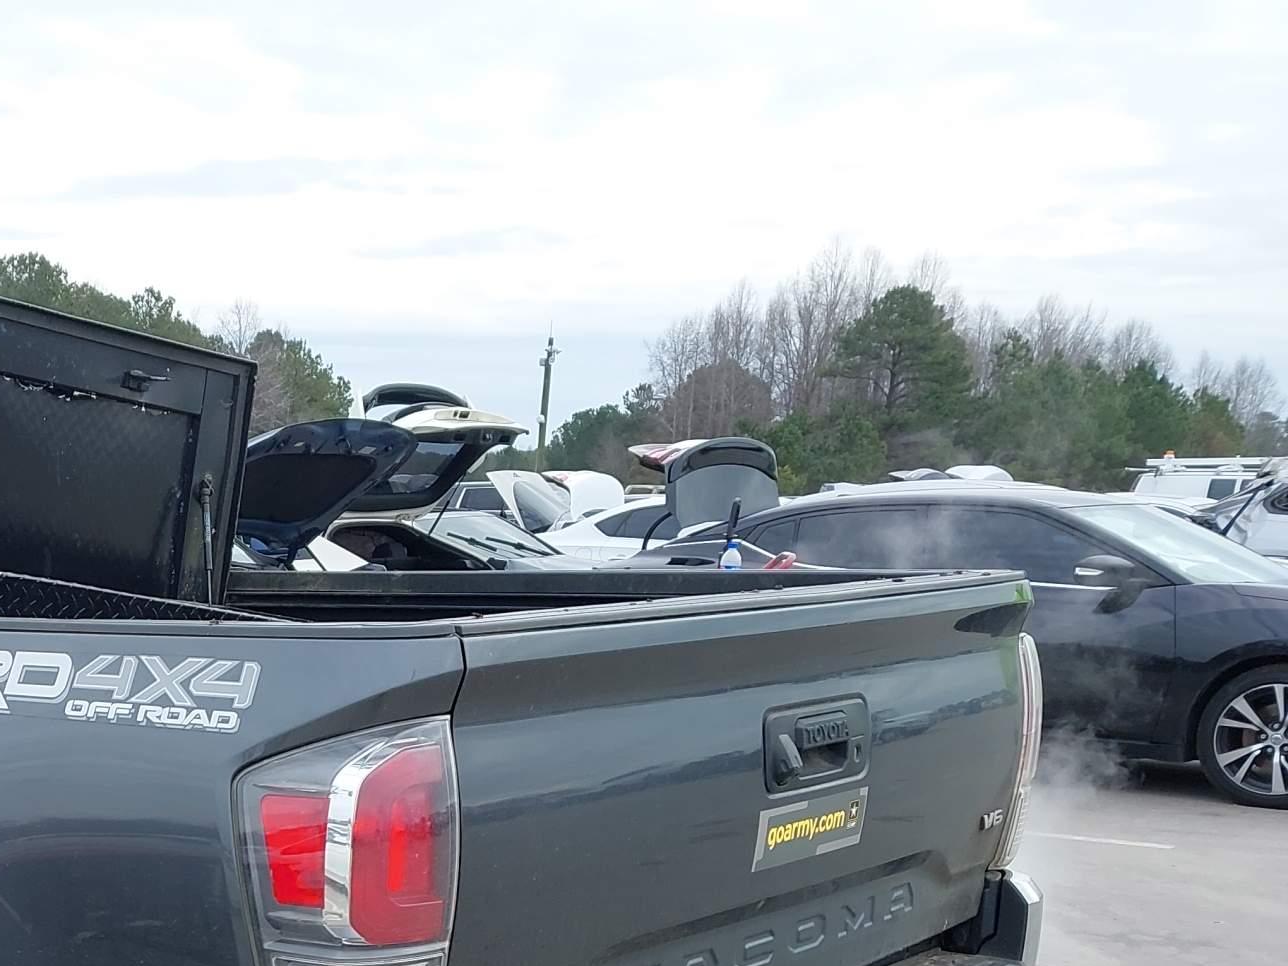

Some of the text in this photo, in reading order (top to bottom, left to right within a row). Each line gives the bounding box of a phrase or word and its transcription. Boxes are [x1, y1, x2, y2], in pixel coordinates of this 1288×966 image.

[64, 698, 241, 734] OFF ROAD
[805, 720, 850, 744] TOYOTA
[766, 809, 847, 850] goarmy.com
[982, 808, 1003, 830] V6
